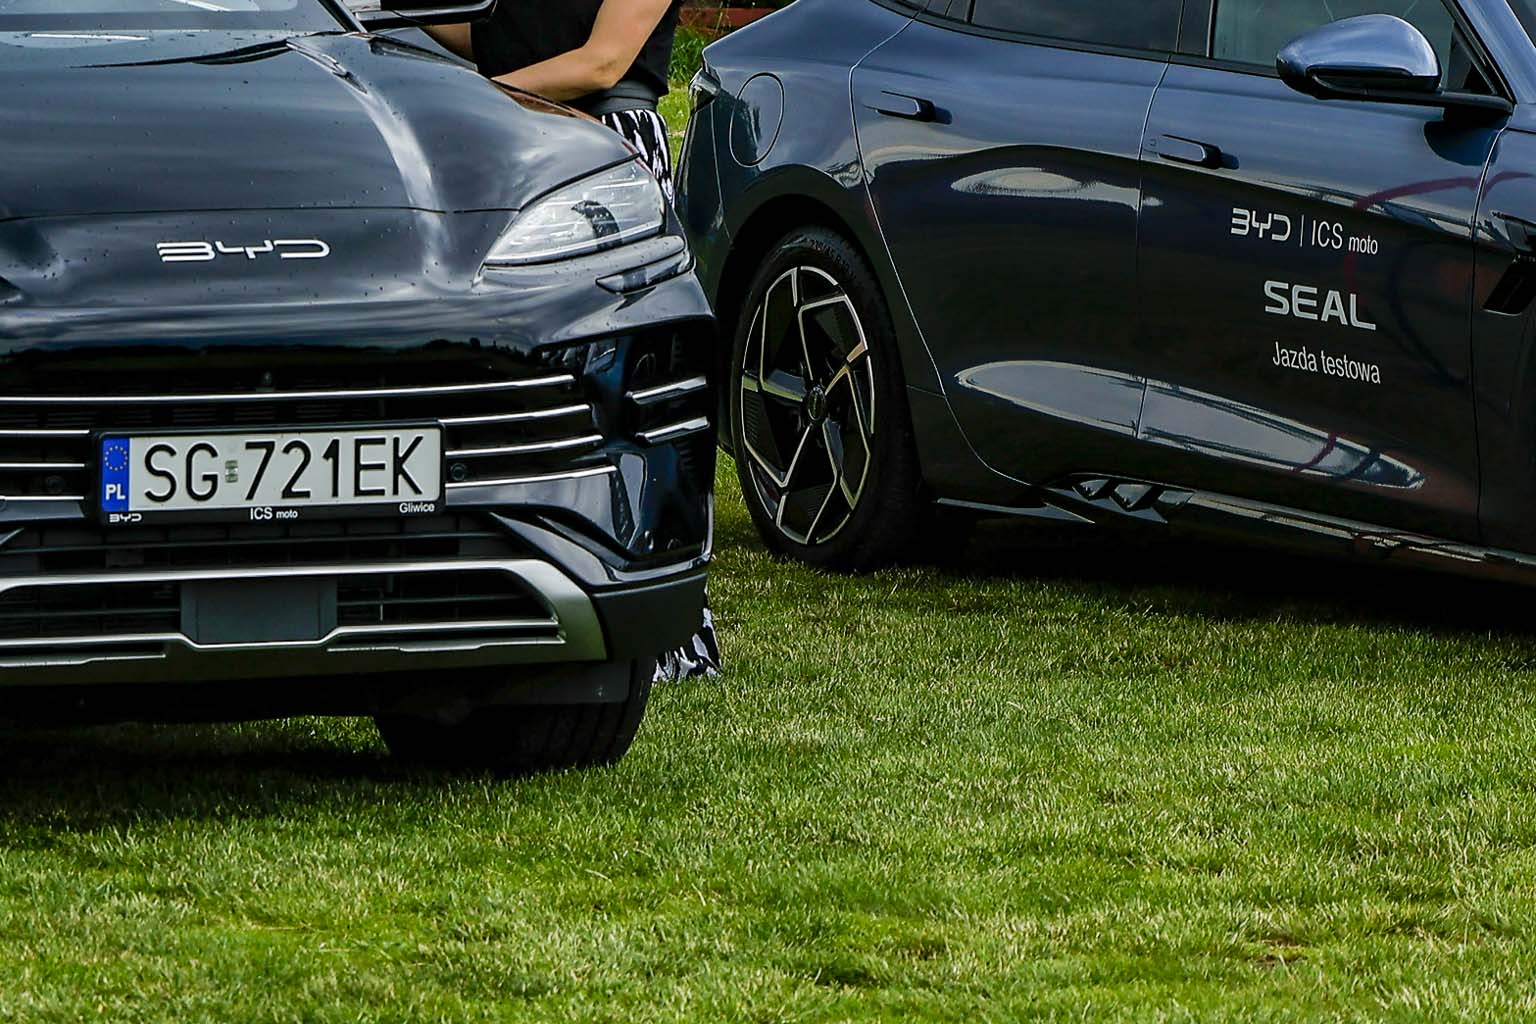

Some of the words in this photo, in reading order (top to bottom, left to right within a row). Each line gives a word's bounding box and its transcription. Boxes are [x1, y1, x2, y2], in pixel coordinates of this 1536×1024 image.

[1230, 207, 1291, 242] BYD
[1311, 220, 1343, 249] ICS
[1348, 235, 1378, 255] moto
[156, 240, 330, 262] BYD
[1263, 280, 1376, 330] SEAL
[1272, 341, 1318, 372] Jazda
[1320, 350, 1381, 384] testowa
[144, 442, 219, 502] SG
[244, 435, 424, 501] 721EK
[105, 484, 126, 501] PL
[109, 513, 142, 523] BYD
[250, 507, 273, 520] ICS
[276, 509, 298, 519] moto
[399, 502, 435, 514] Gliwice
